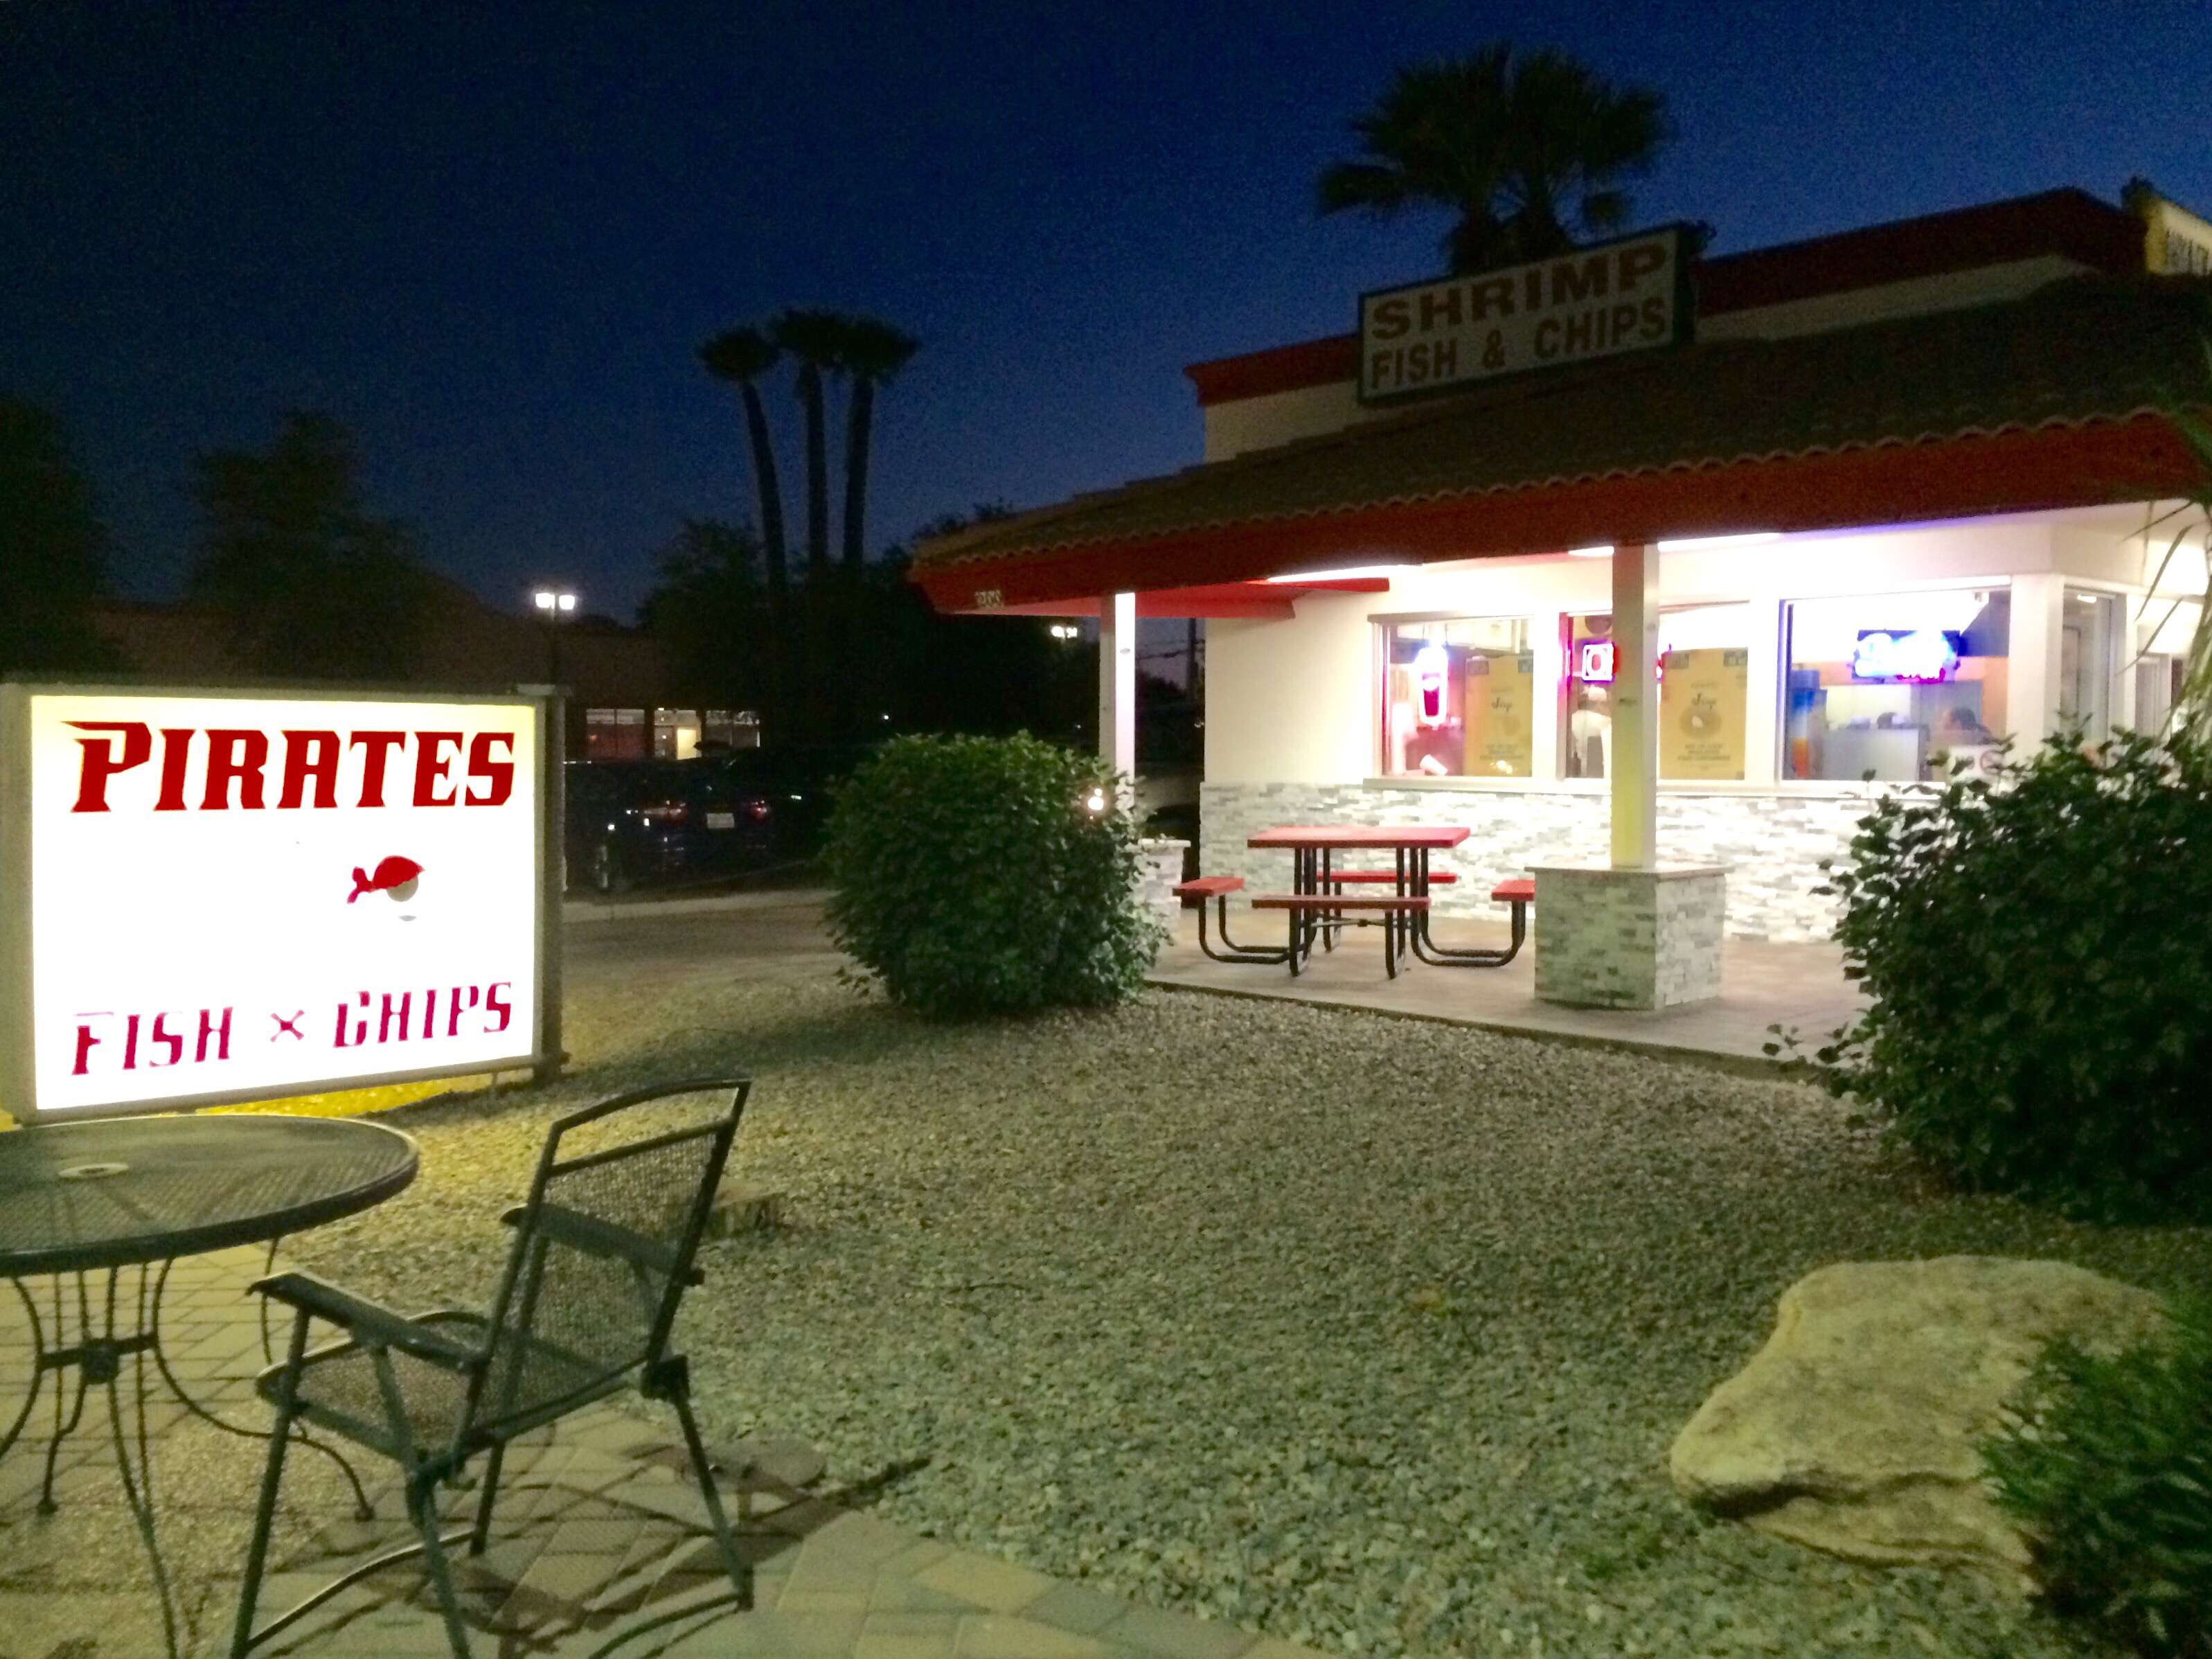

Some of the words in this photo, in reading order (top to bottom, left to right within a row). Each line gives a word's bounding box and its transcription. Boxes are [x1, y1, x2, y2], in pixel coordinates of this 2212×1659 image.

[1371, 242, 1664, 340] SHRIMP
[1371, 340, 1454, 390] FISH
[1481, 329, 1506, 370] &
[1534, 296, 1666, 360] CHIPS
[61, 720, 515, 814] PIRATES
[71, 1006, 233, 1076] FISH
[332, 982, 512, 1049] CHIPS
